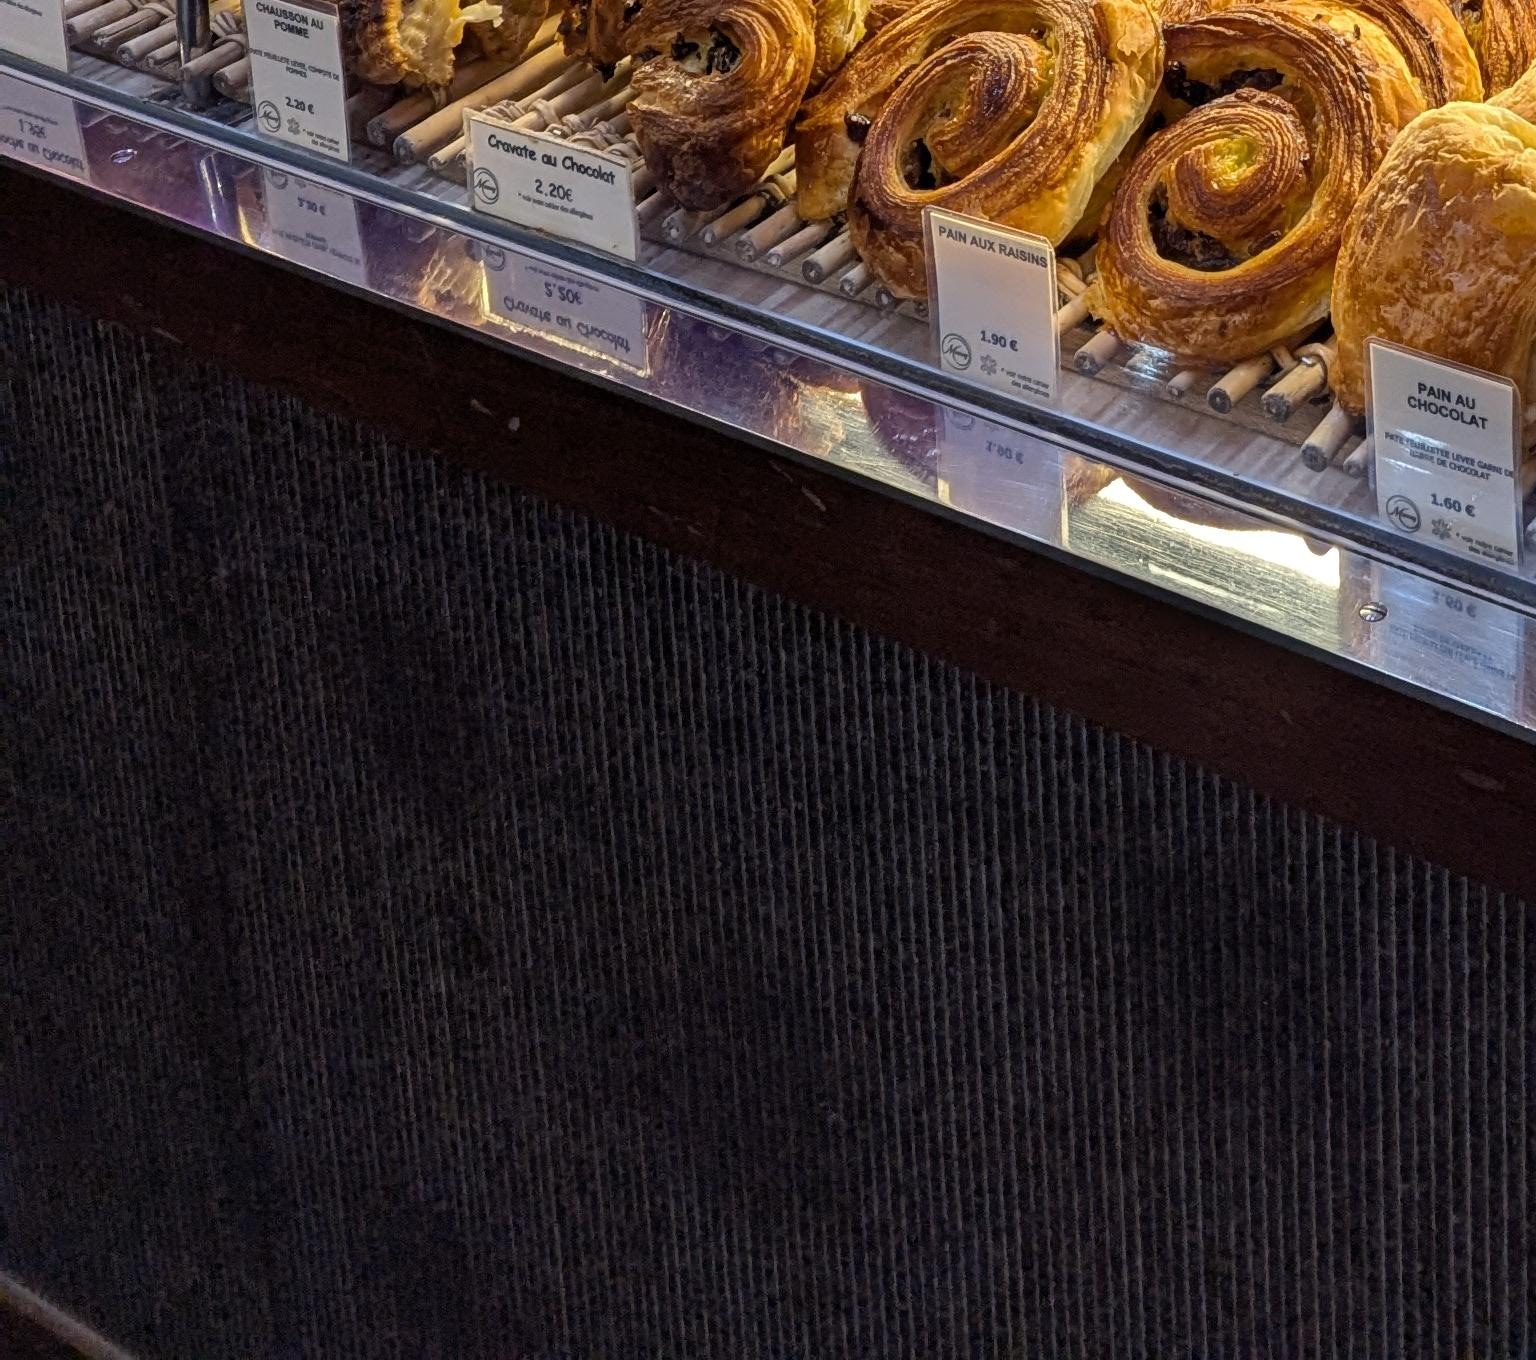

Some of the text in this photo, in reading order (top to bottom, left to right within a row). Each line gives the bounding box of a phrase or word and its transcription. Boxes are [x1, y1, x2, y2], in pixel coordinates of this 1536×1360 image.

[256, 1, 324, 30] CHAUSSON AU
[274, 19, 310, 38] POMME
[285, 96, 314, 115] 2.20 €
[488, 134, 616, 185] Cravate au Chocolat
[534, 178, 574, 203] 2.20€
[938, 225, 1049, 269] PAIN AUX RAISINS
[980, 330, 1019, 352] 1.90 €
[1417, 382, 1476, 410] PAIN AU
[1407, 396, 1488, 430] CHOCOLAT
[1430, 493, 1475, 517] 1.60 €
